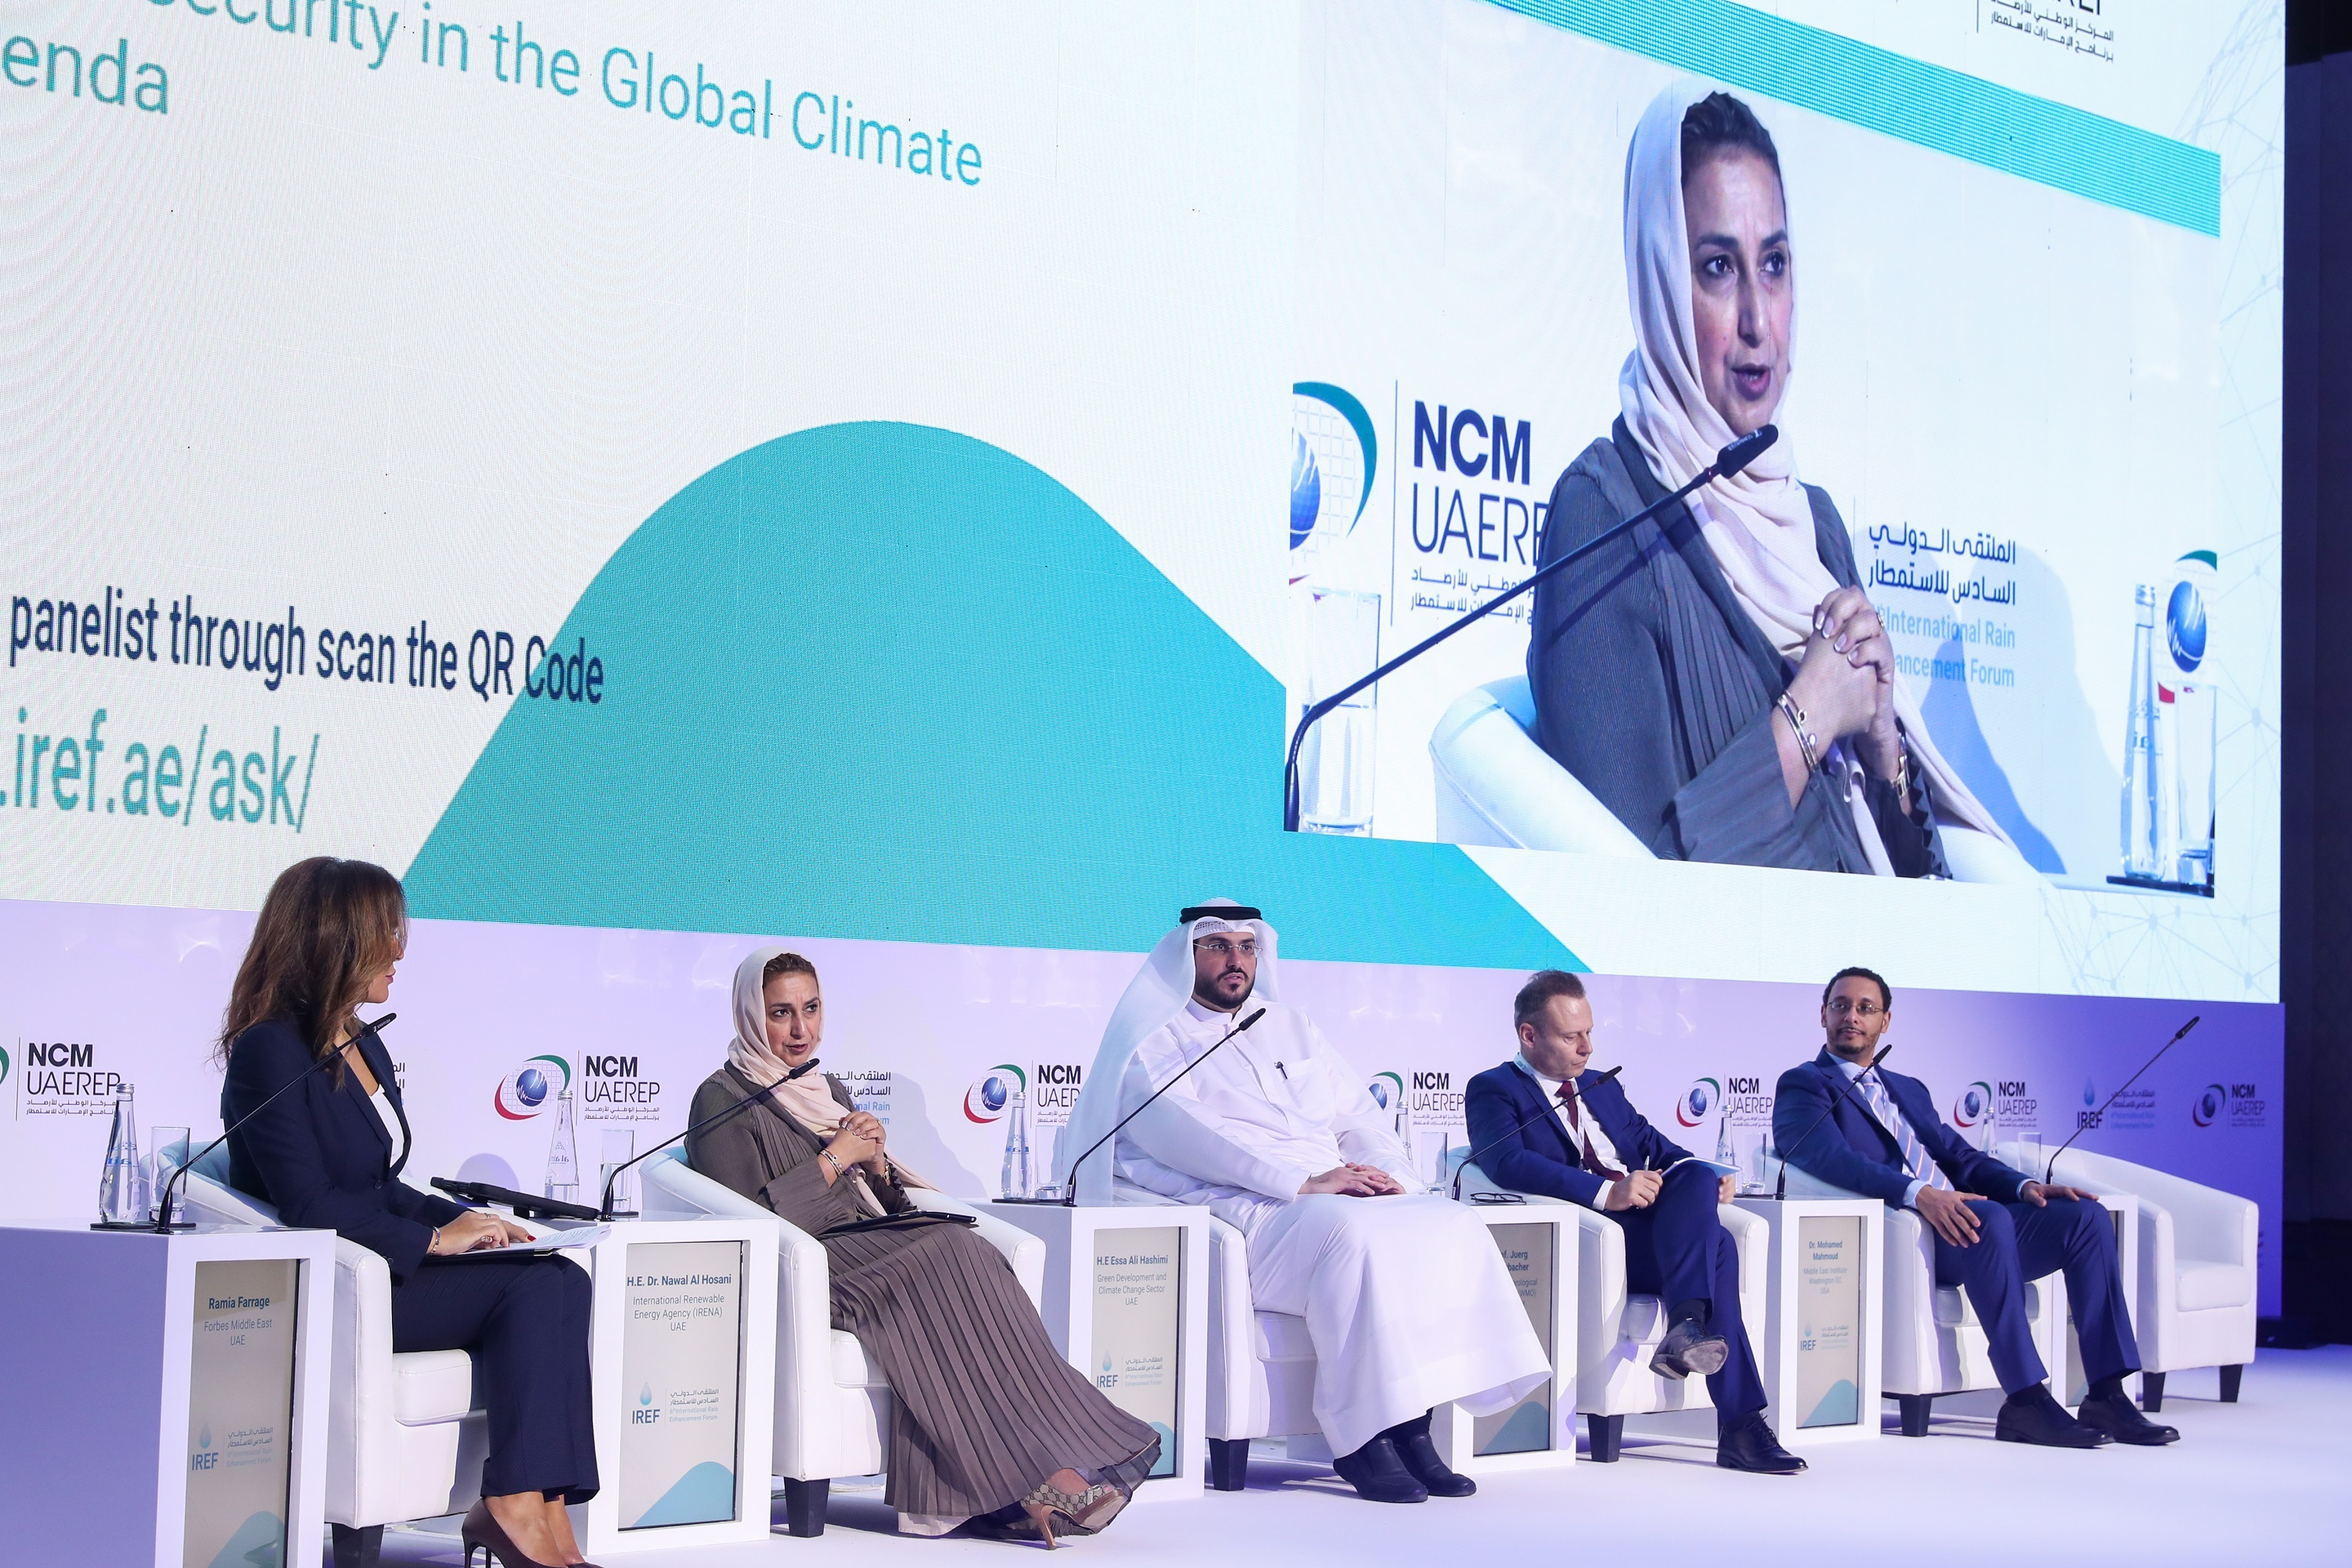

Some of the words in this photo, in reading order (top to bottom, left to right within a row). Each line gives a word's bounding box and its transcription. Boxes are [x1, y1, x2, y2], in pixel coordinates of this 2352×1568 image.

[2, 34, 168, 114] enda
[421, 2, 468, 71] in
[490, 20, 579, 96] the
[602, 46, 771, 139] Global
[793, 90, 982, 186] Climate
[1414, 400, 1531, 486] NCM
[1869, 521, 1950, 555] الدولي
[1952, 532, 2016, 564] الملتقى
[1868, 559, 1949, 595] للاستمطار
[1952, 576, 2016, 606] السادس
[1985, 620, 2016, 648] Rain
[10, 586, 158, 668] panelist
[170, 594, 305, 691] through
[316, 630, 394, 684] scan
[406, 620, 458, 690] the
[469, 630, 514, 701] QR
[525, 635, 604, 705] Code
[1970, 659, 2015, 688] Forum
[28, 1043, 93, 1067] NCM
[586, 1055, 638, 1077] NCM
[854, 1071, 891, 1081] الملتقى
[1038, 1065, 1081, 1084] NCM
[1414, 1072, 1450, 1090] NCM
[27, 1071, 121, 1095] UAEREP
[1729, 1078, 1759, 1094] NCM
[1998, 1082, 2025, 1097] NCM
[2231, 1084, 2256, 1098] NCM
[585, 1080, 660, 1103] UAEREP
[873, 1102, 891, 1111] Rain
[1413, 1093, 1465, 1111] UAEREP
[1998, 1099, 2037, 1115] UAEREP
[2231, 1101, 2265, 1115] UAEREP
[2078, 1112, 2103, 1129] IREF
[1097, 1256, 1109, 1265] H.E
[1111, 1256, 1127, 1265] Essa
[1129, 1255, 1138, 1265] Ali
[1140, 1254, 1168, 1265] Hashimi
[1510, 1250, 1528, 1260] Juerg
[627, 1276, 645, 1287] H.E.
[648, 1276, 659, 1286] Dr.
[662, 1275, 688, 1286] Nawal
[691, 1275, 700, 1285] Al
[702, 1274, 731, 1284] Hosani
[1116, 1273, 1154, 1283] Development
[1098, 1286, 1121, 1294] Climate
[1123, 1285, 1145, 1295] Change
[209, 1297, 235, 1309] Ramia
[238, 1297, 270, 1309] Farrage
[633, 1295, 681, 1305] International
[684, 1294, 724, 1304] Renewable
[634, 1310, 661, 1320] Energy
[662, 1309, 691, 1320] Agency
[693, 1307, 723, 1319] (IRENA)
[204, 1321, 229, 1332] Forbes
[231, 1319, 255, 1330] Middle
[257, 1319, 272, 1328] East
[670, 1322, 687, 1331] UAE
[230, 1335, 245, 1345] UAE
[1800, 1340, 1816, 1351] IREF
[1097, 1374, 1118, 1388] IREF
[632, 1409, 660, 1425] IREF
[192, 1452, 219, 1471] IREF
